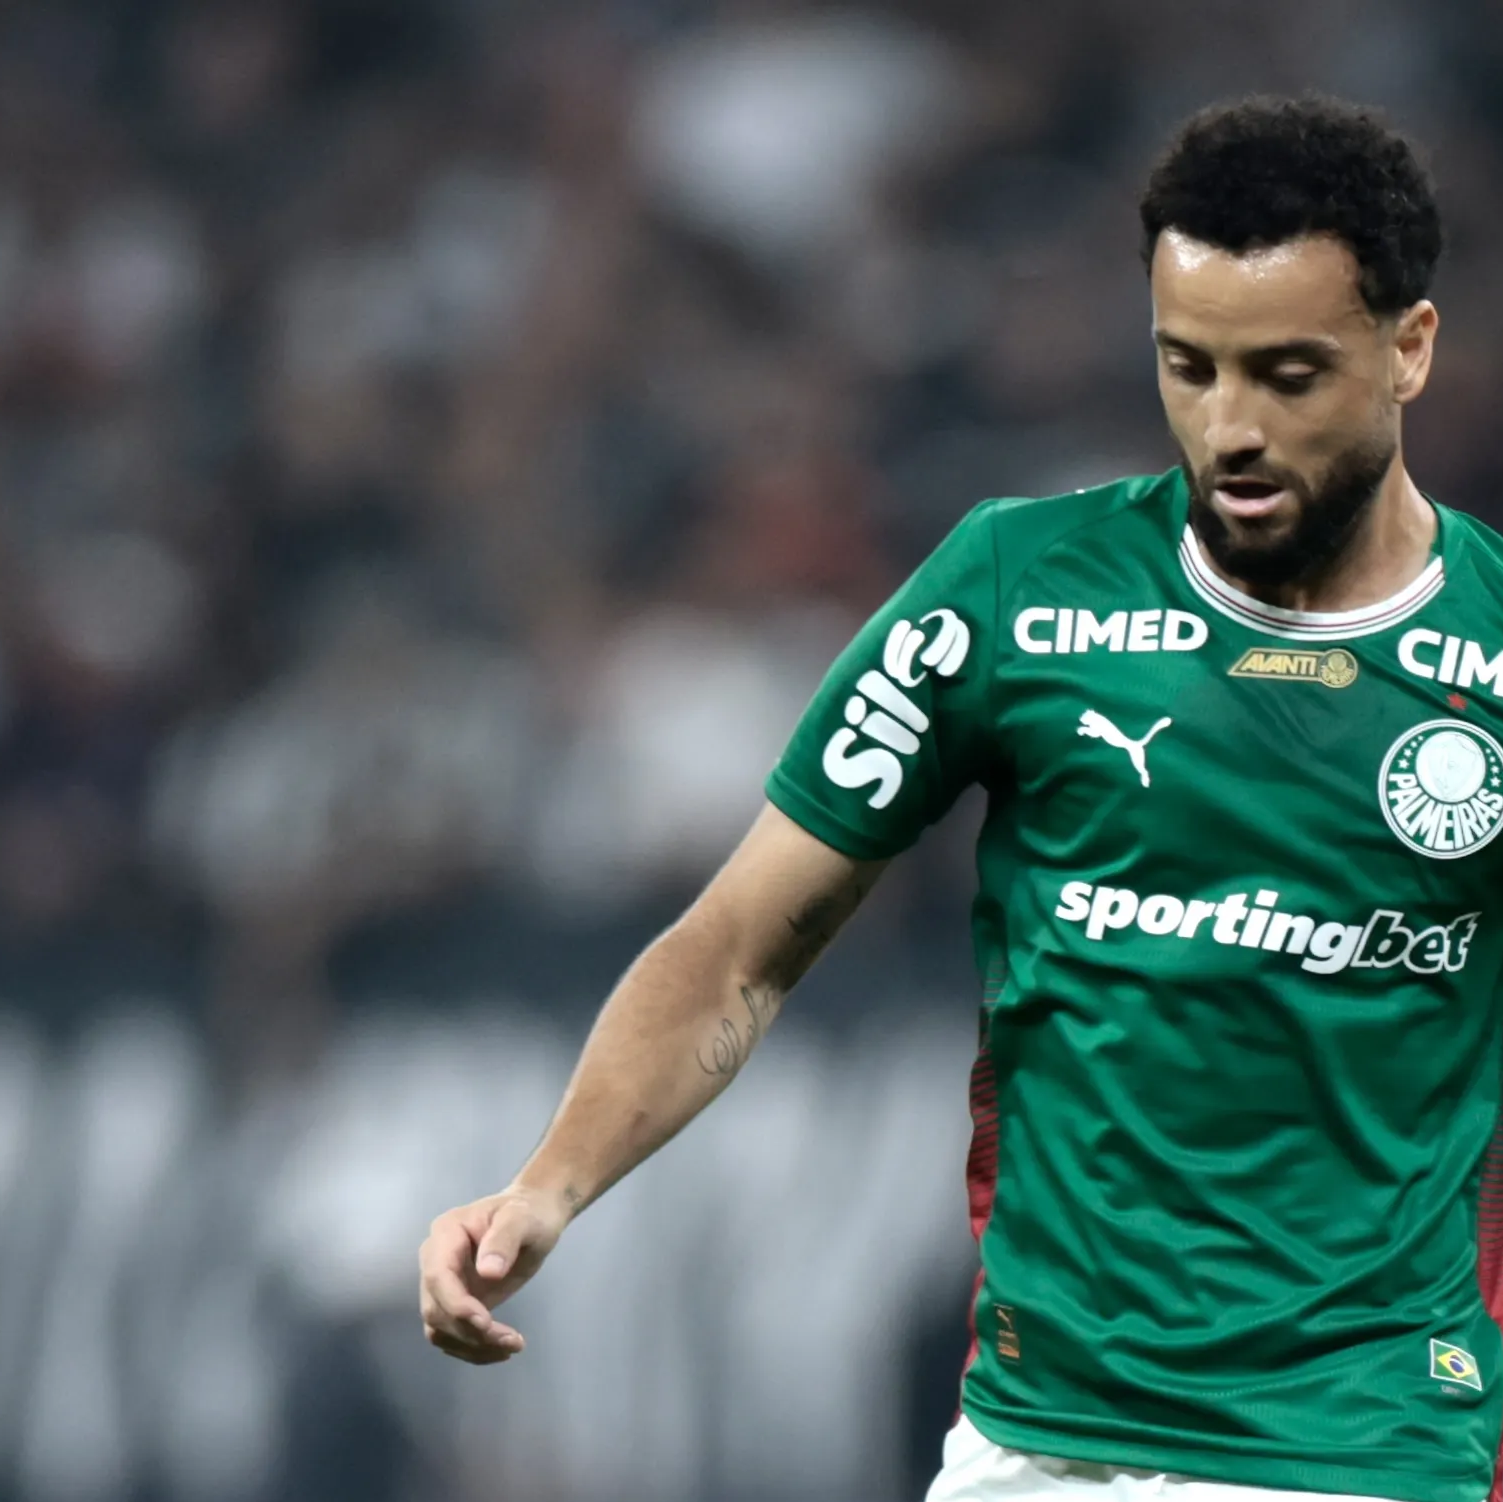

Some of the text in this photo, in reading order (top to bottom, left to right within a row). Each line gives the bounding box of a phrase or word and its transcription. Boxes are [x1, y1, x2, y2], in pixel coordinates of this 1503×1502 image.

[1014, 607, 1209, 653] CIMED
[1240, 653, 1317, 675] AVANTI
[1055, 880, 1482, 975] sportingbet
